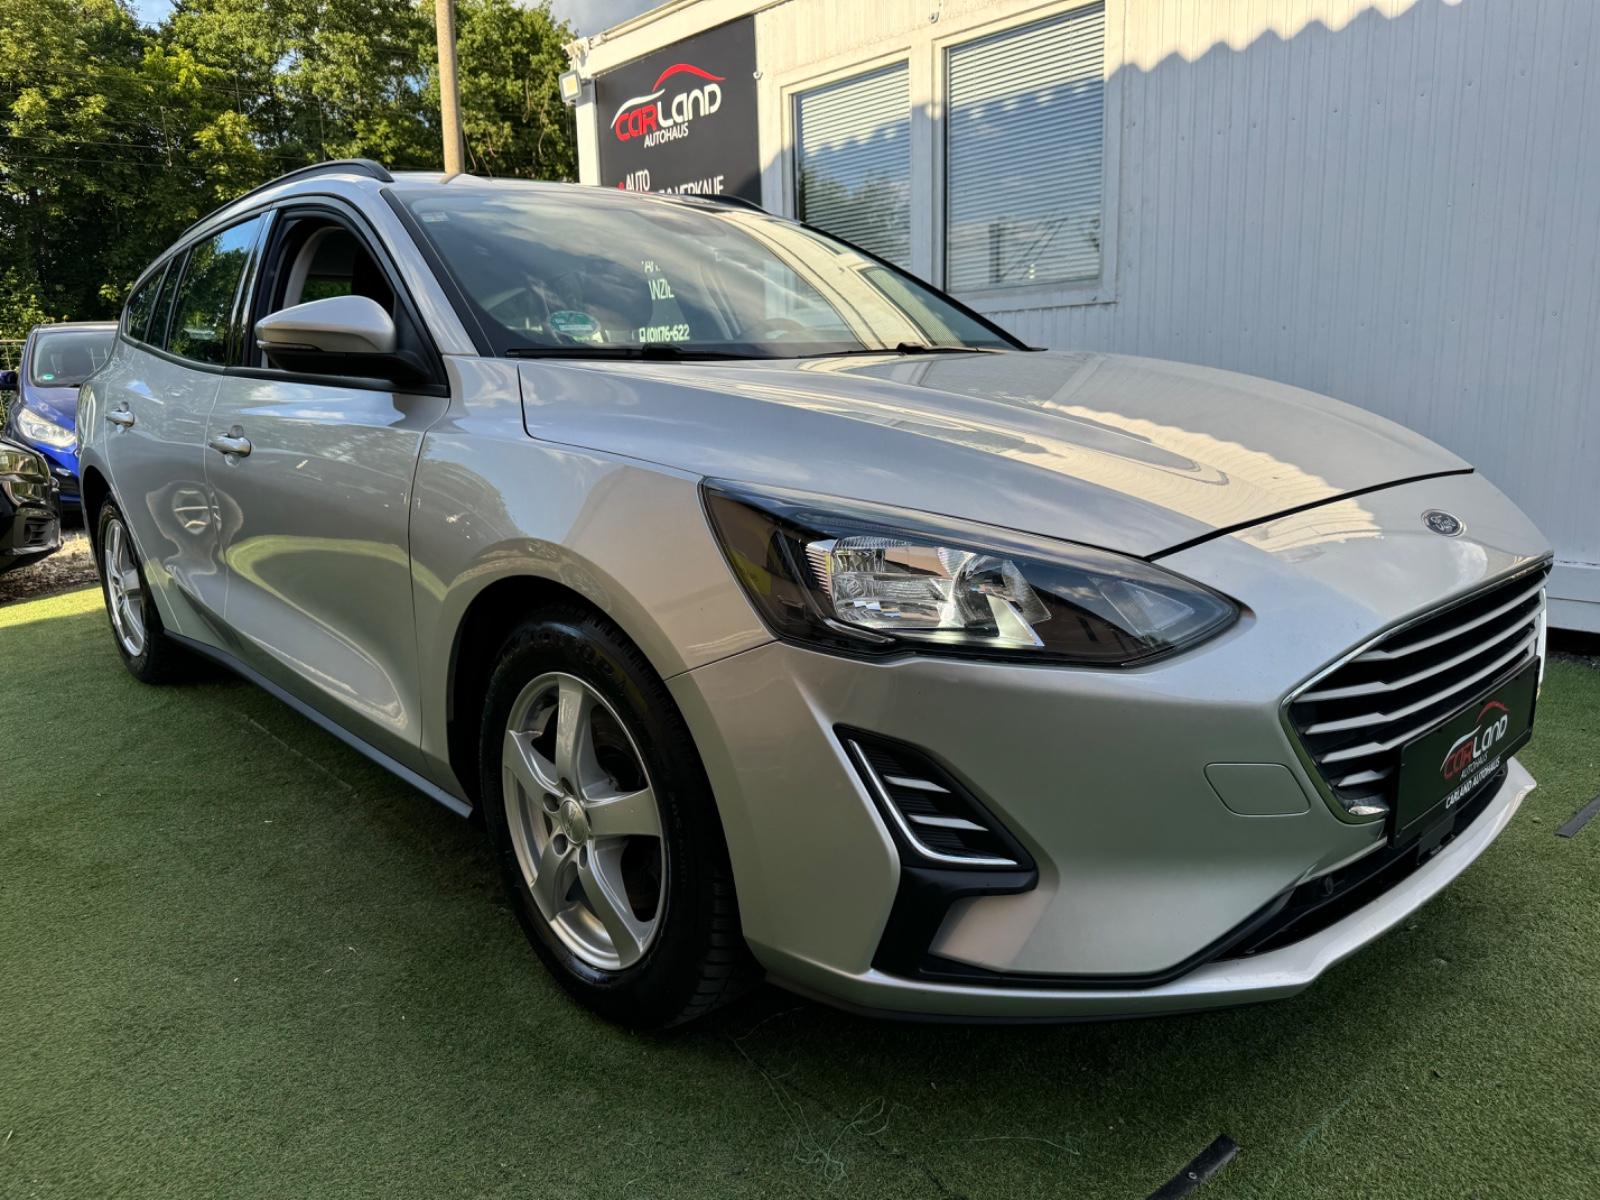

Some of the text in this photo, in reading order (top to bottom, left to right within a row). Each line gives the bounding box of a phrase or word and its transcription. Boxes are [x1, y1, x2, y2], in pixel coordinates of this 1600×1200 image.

[615, 83, 722, 142] CARLAND
[643, 123, 689, 148] AUTOHAUS
[625, 169, 651, 192] AUTO
[1443, 714, 1508, 780] CARLAND
[1445, 779, 1472, 809] CARLAND
